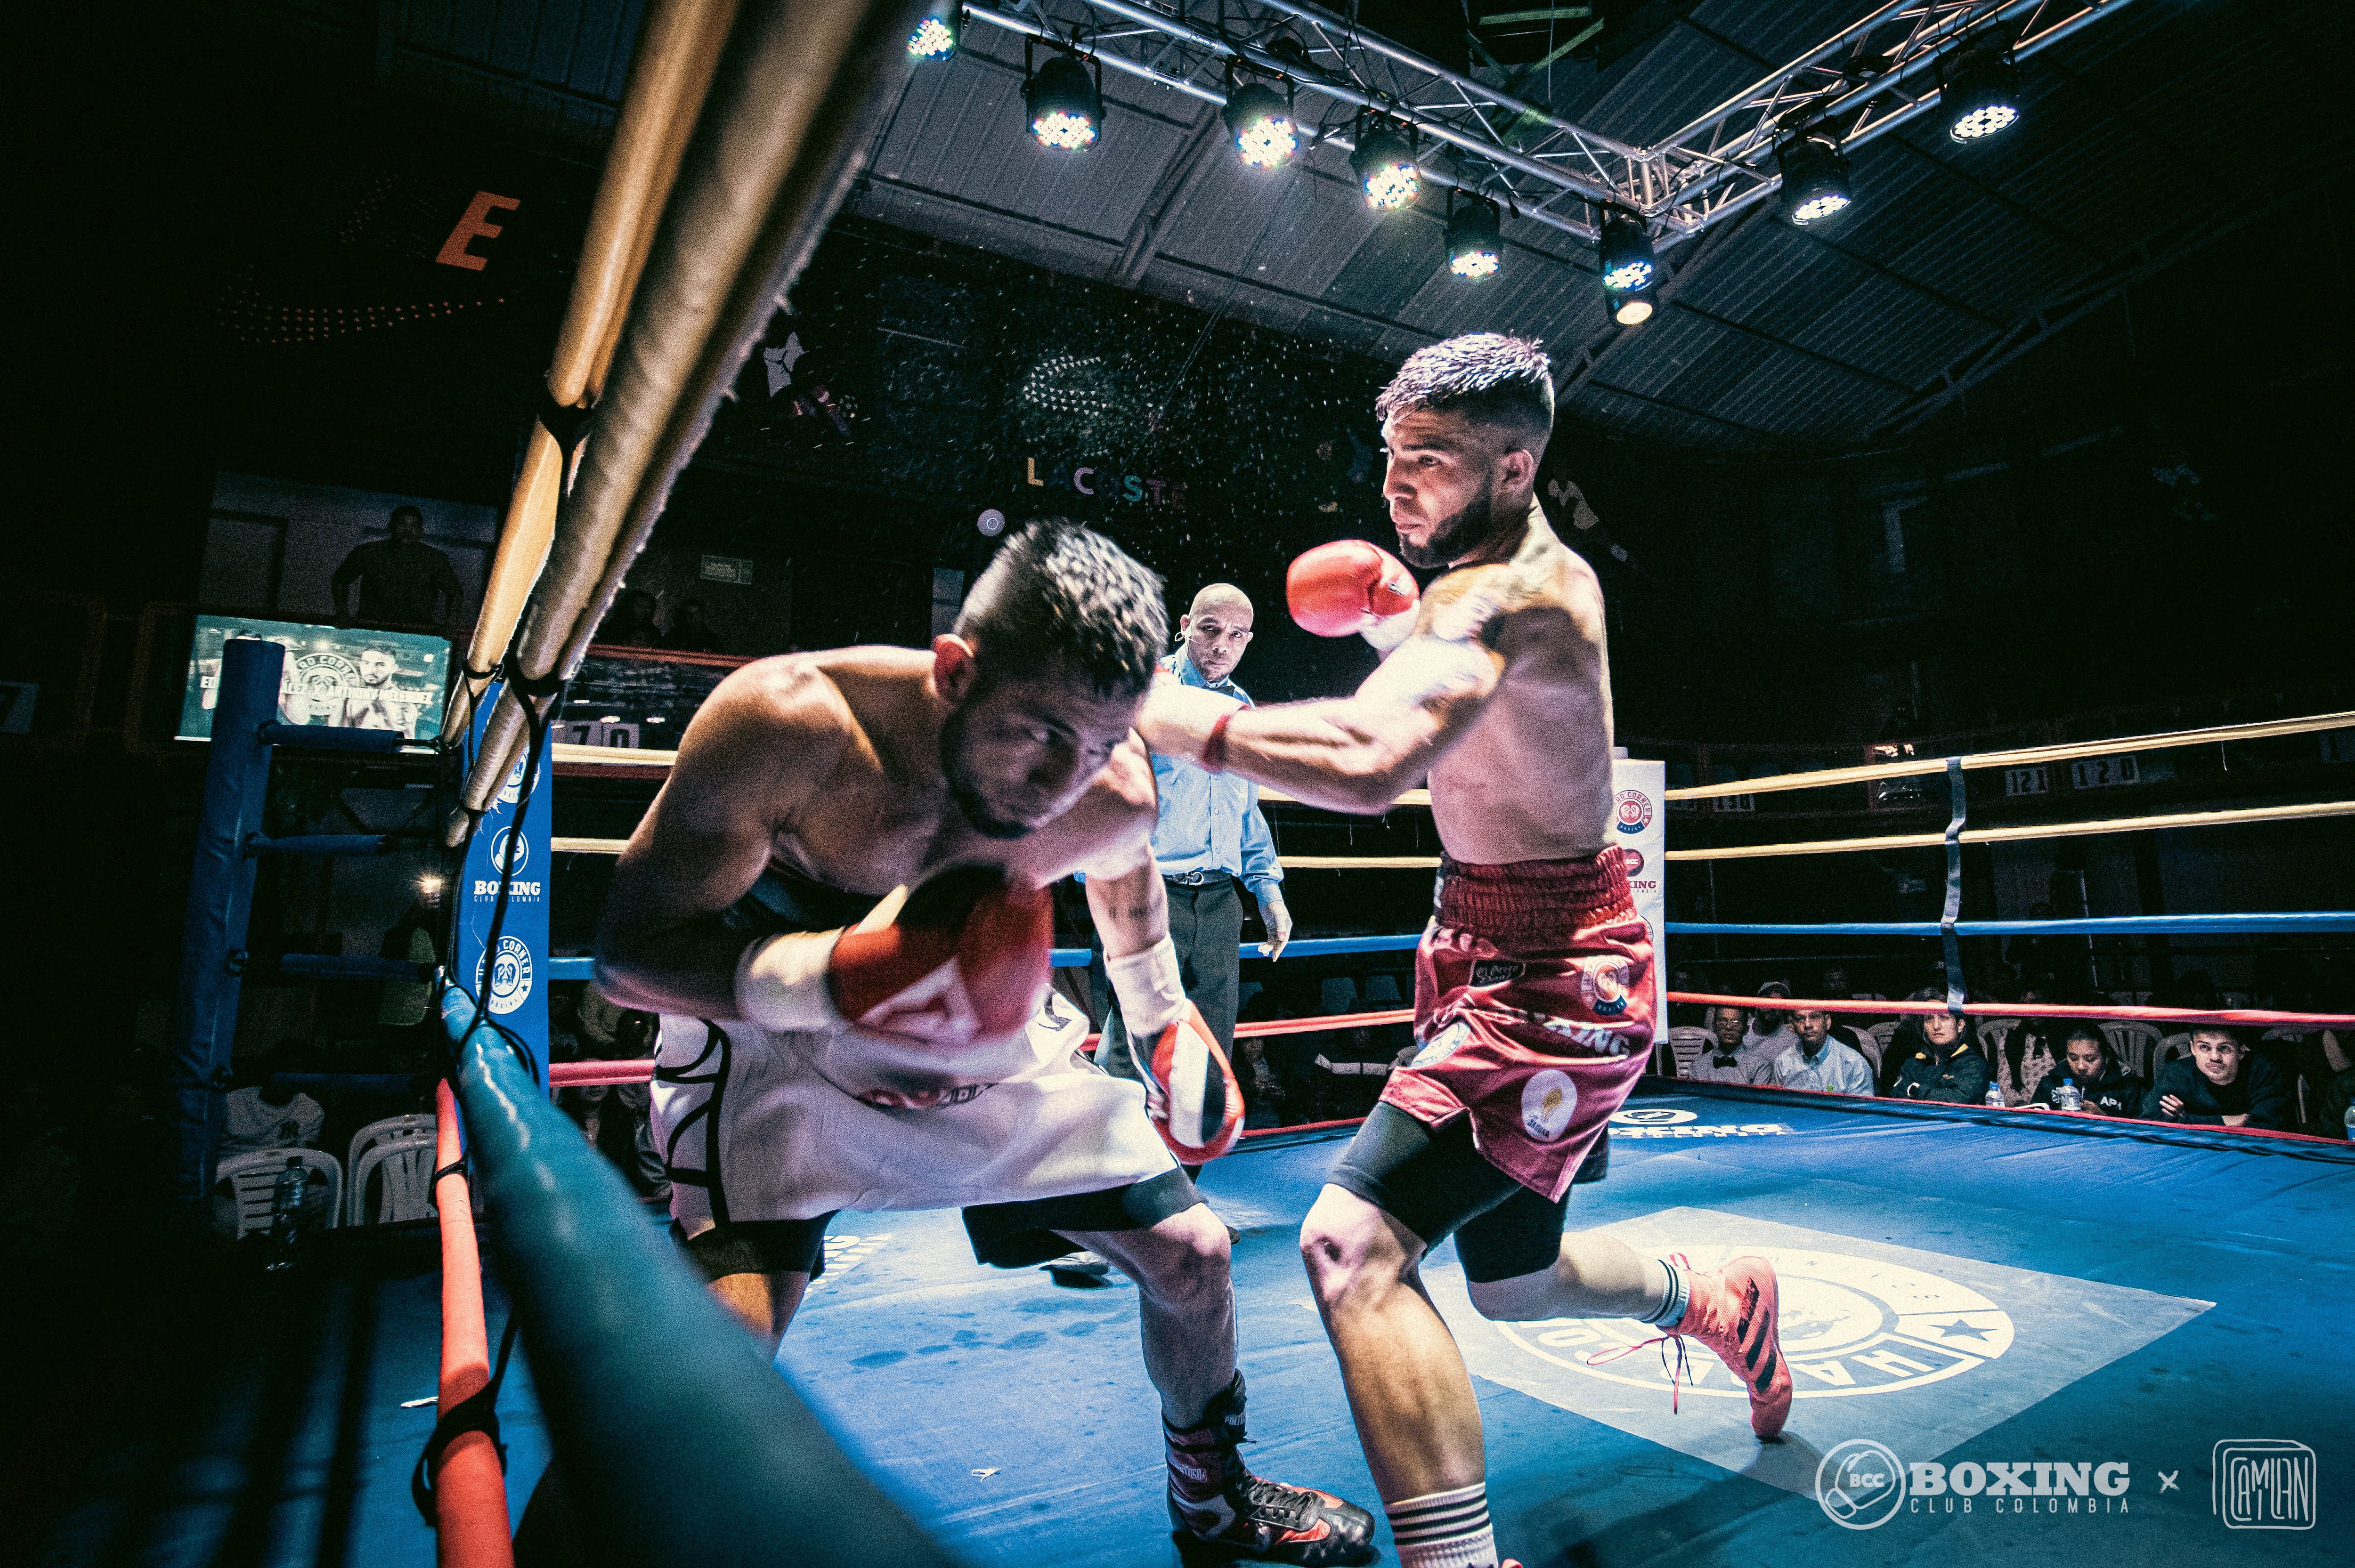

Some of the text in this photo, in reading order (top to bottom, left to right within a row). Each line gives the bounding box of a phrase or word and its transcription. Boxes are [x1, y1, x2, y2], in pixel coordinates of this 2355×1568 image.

[436, 191, 521, 272] E
[1627, 792, 1651, 812] CORNER
[474, 880, 541, 896] BOING
[503, 939, 531, 974] CORNER
[1659, 1349, 1935, 1387] HAD
